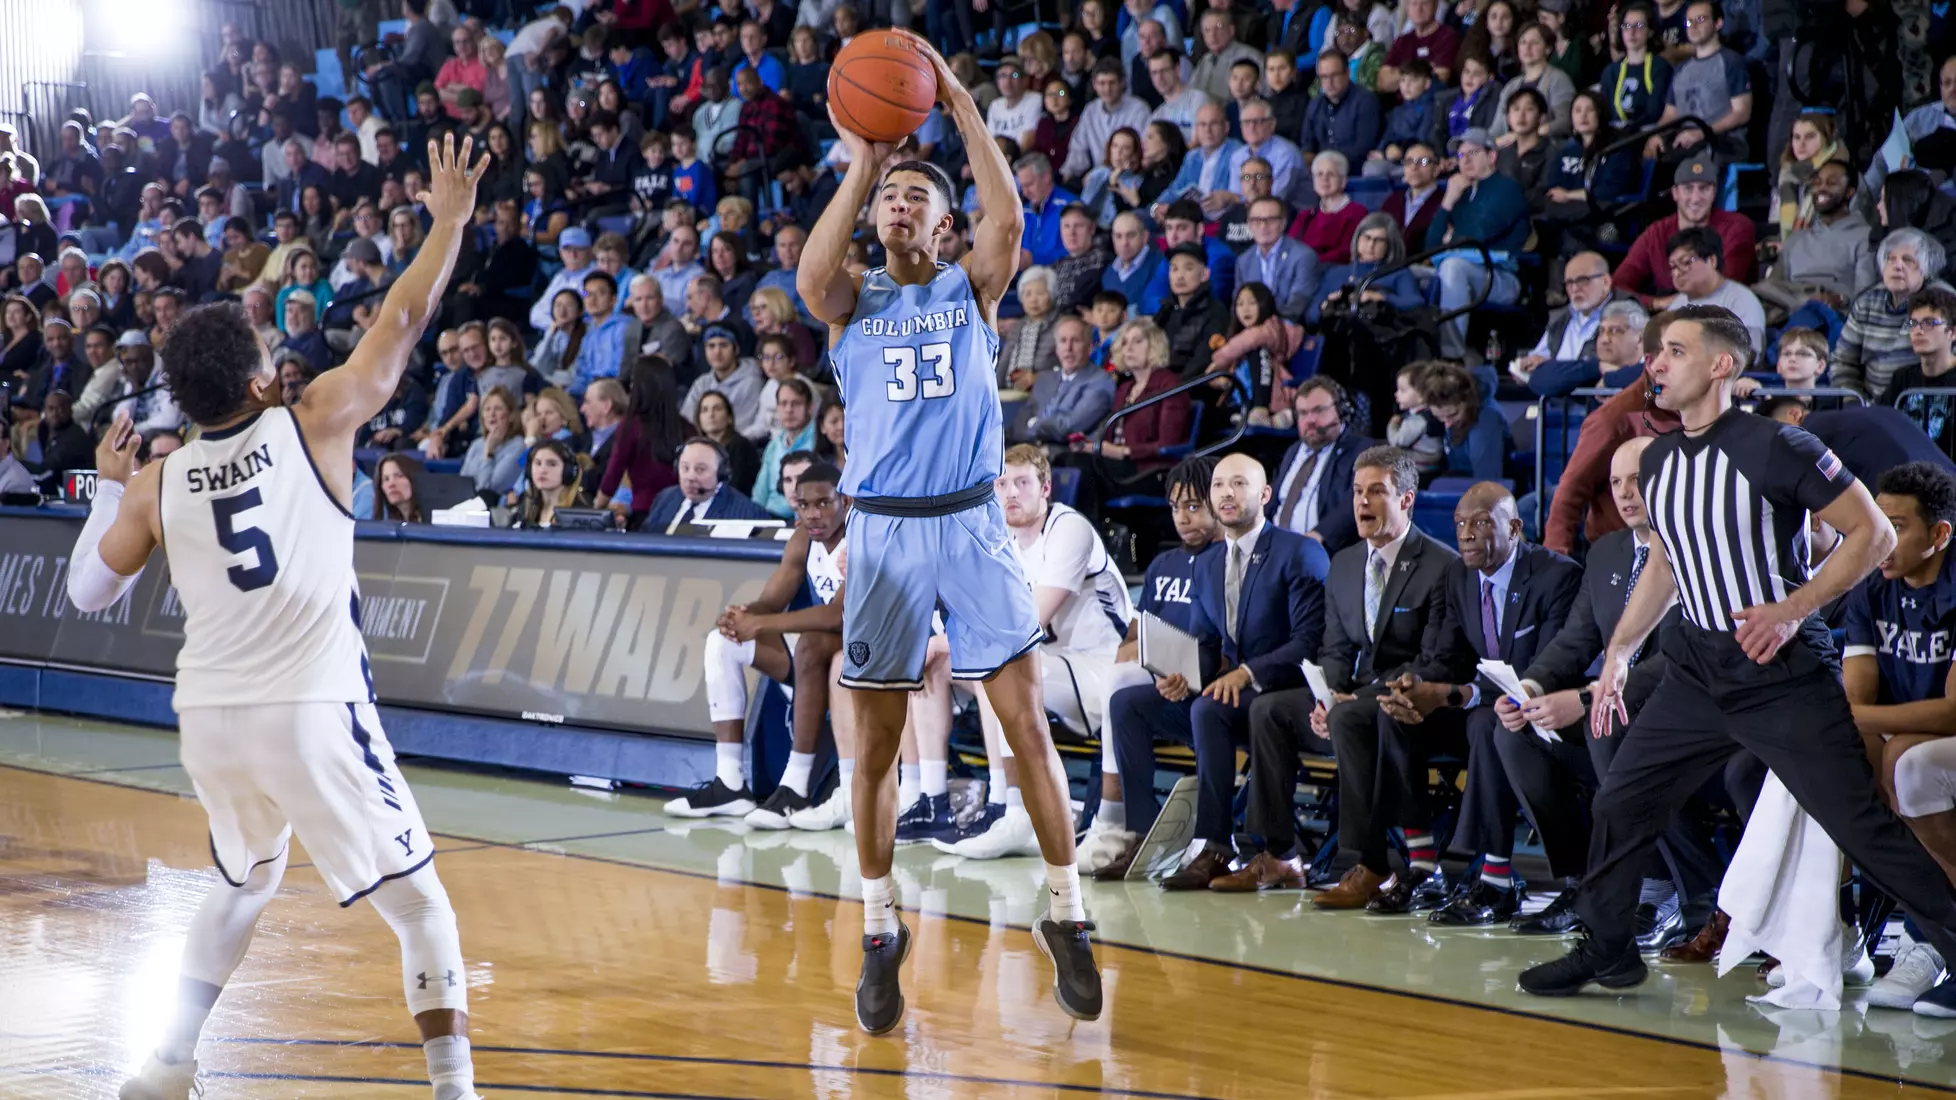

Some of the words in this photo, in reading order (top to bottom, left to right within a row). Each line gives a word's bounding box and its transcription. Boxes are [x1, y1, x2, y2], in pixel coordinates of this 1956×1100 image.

[861, 308, 970, 338] COLUMBIA
[883, 341, 957, 403] 33
[75, 474, 99, 500] PO
[187, 443, 274, 494] SWAIN
[211, 486, 279, 593] 5
[1153, 576, 1192, 605] YAL
[1875, 619, 1952, 664] YALE
[394, 827, 414, 857] Y
